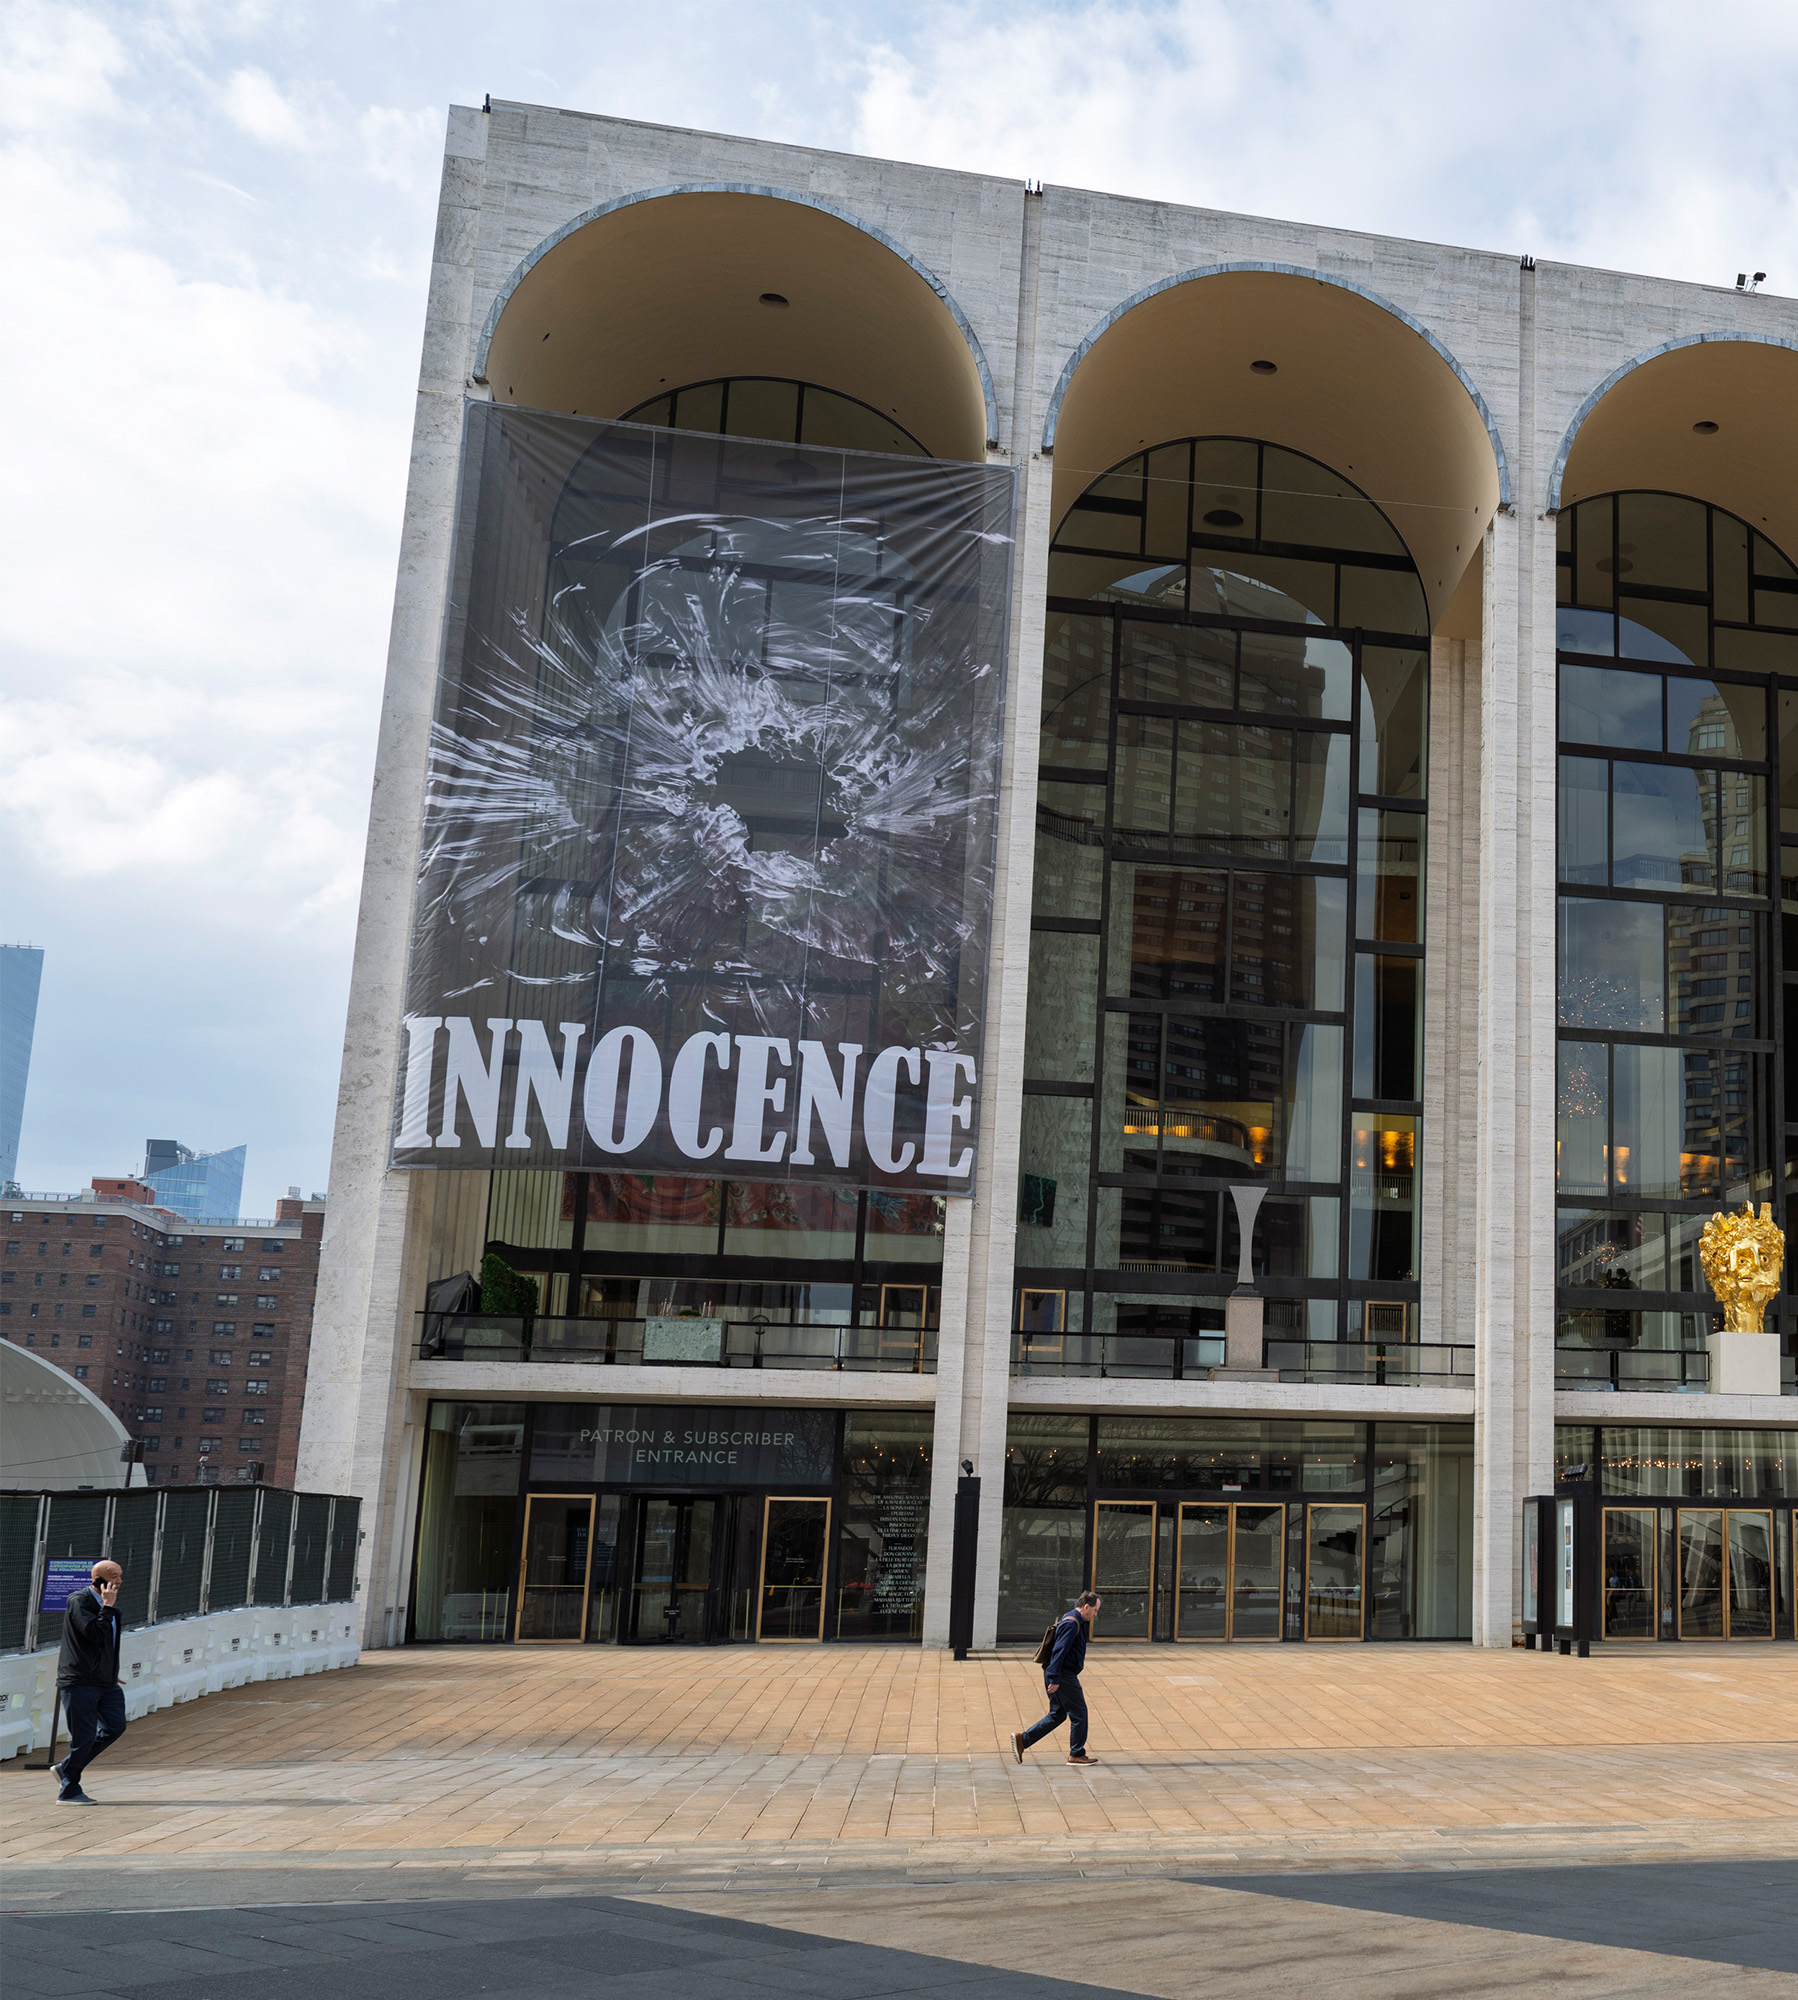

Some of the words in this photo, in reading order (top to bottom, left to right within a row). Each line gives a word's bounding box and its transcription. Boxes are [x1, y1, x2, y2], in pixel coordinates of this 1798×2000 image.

[393, 1016, 977, 1178] INNOCENCE
[580, 1429, 655, 1443] PATRON
[663, 1431, 675, 1444] &
[683, 1431, 795, 1446] SUBSCRIBER
[636, 1450, 738, 1464] ENTRANCE
